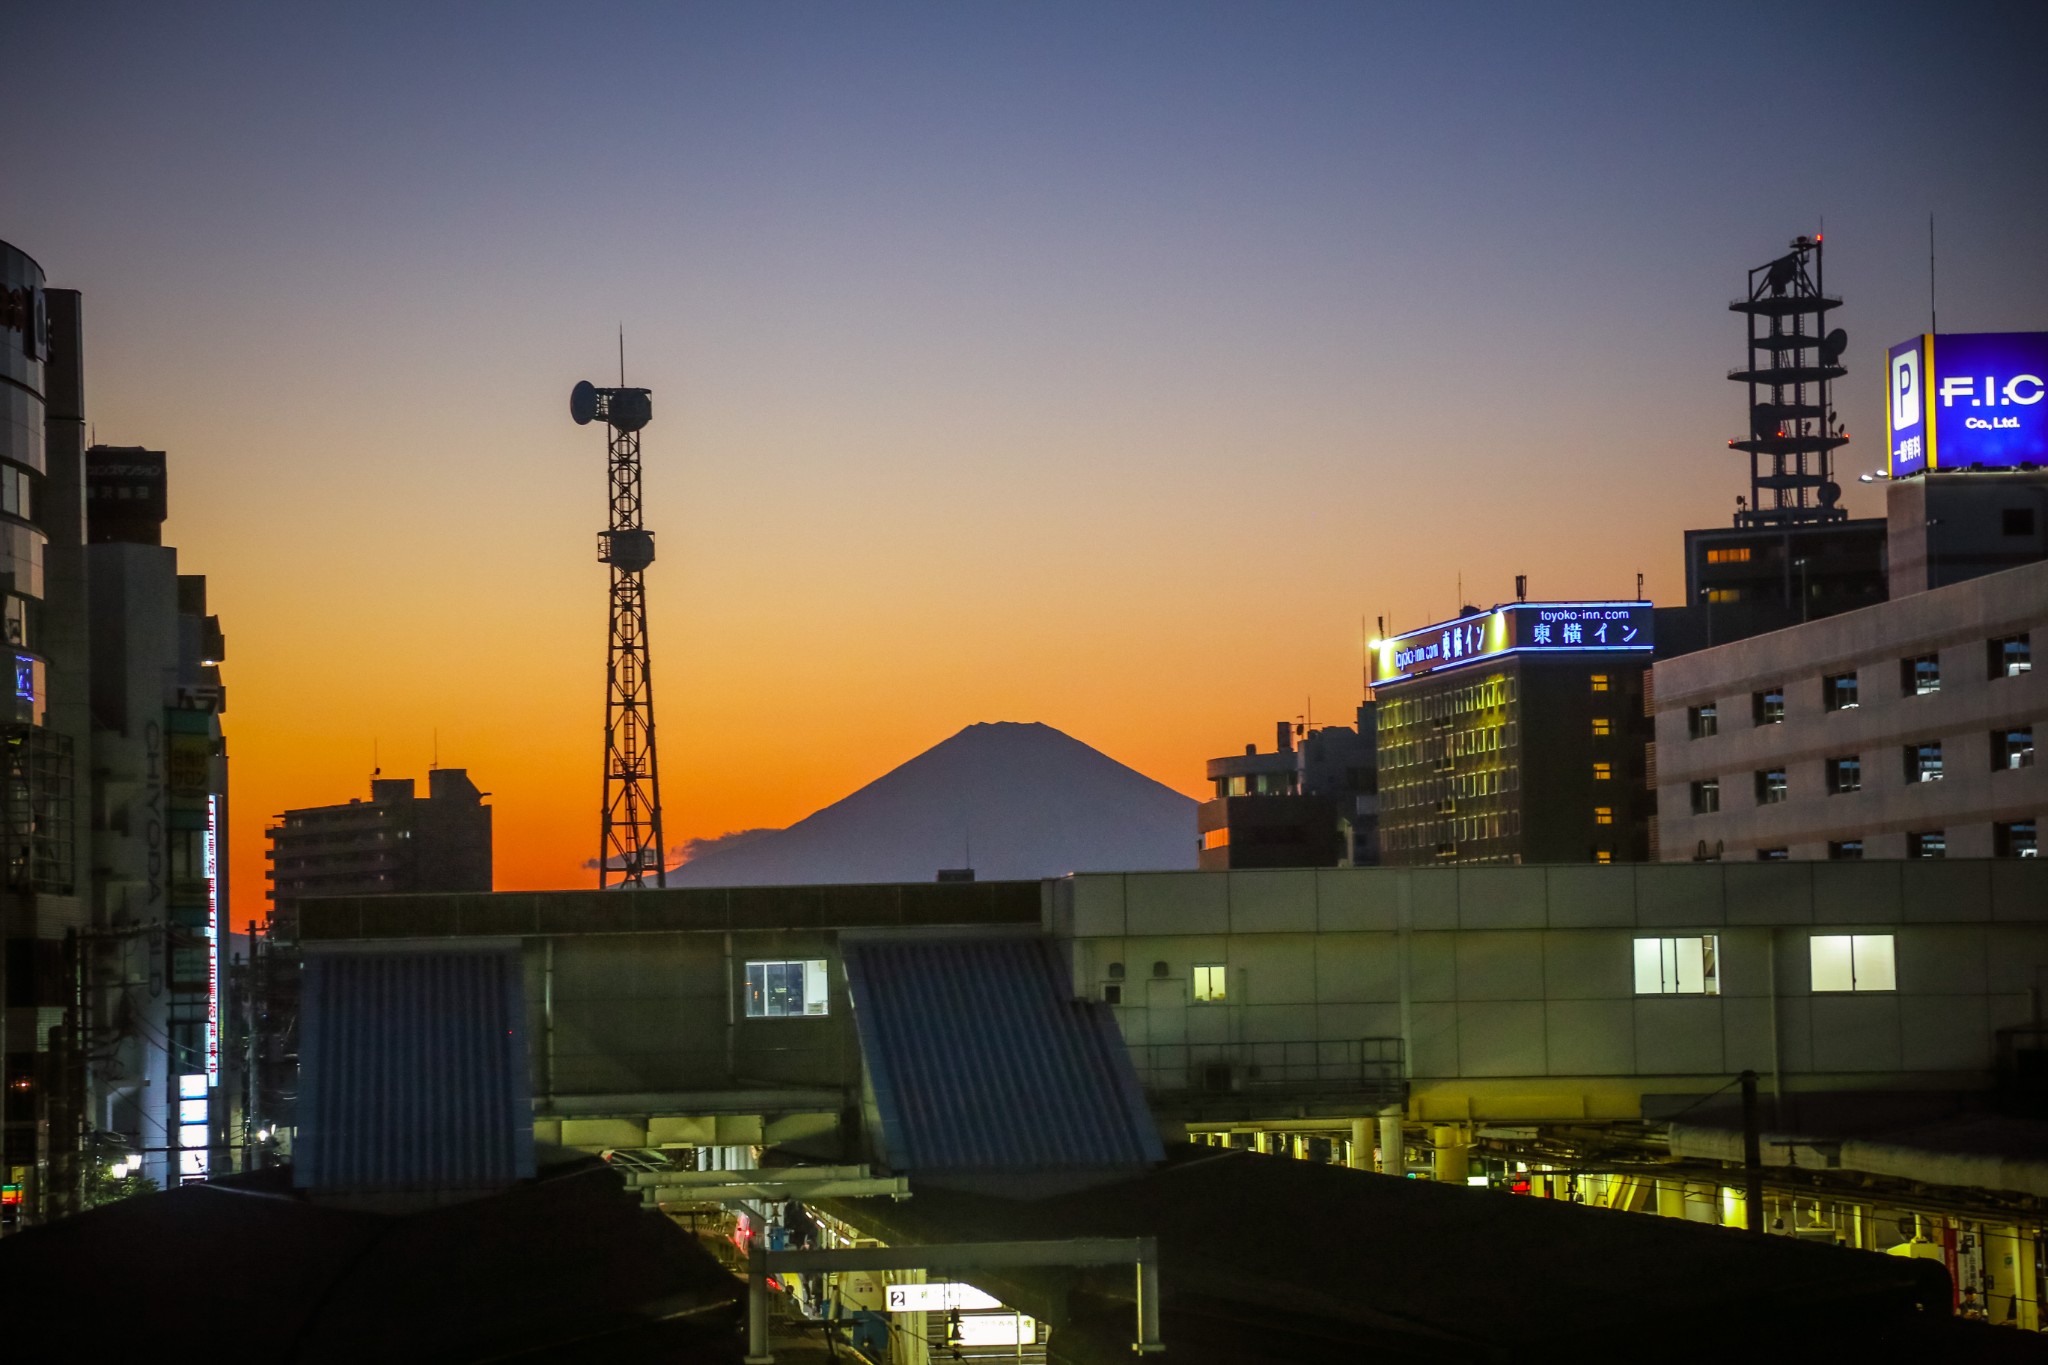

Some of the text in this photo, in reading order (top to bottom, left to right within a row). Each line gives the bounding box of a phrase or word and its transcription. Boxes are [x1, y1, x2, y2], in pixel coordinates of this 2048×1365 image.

[1541, 609, 1629, 622] toyoko-inn.com
[1442, 623, 1485, 660] 東横イン
[1533, 622, 1638, 644] 東横イン
[145, 720, 161, 906] CHIYODA
[892, 1292, 905, 1306] 2
